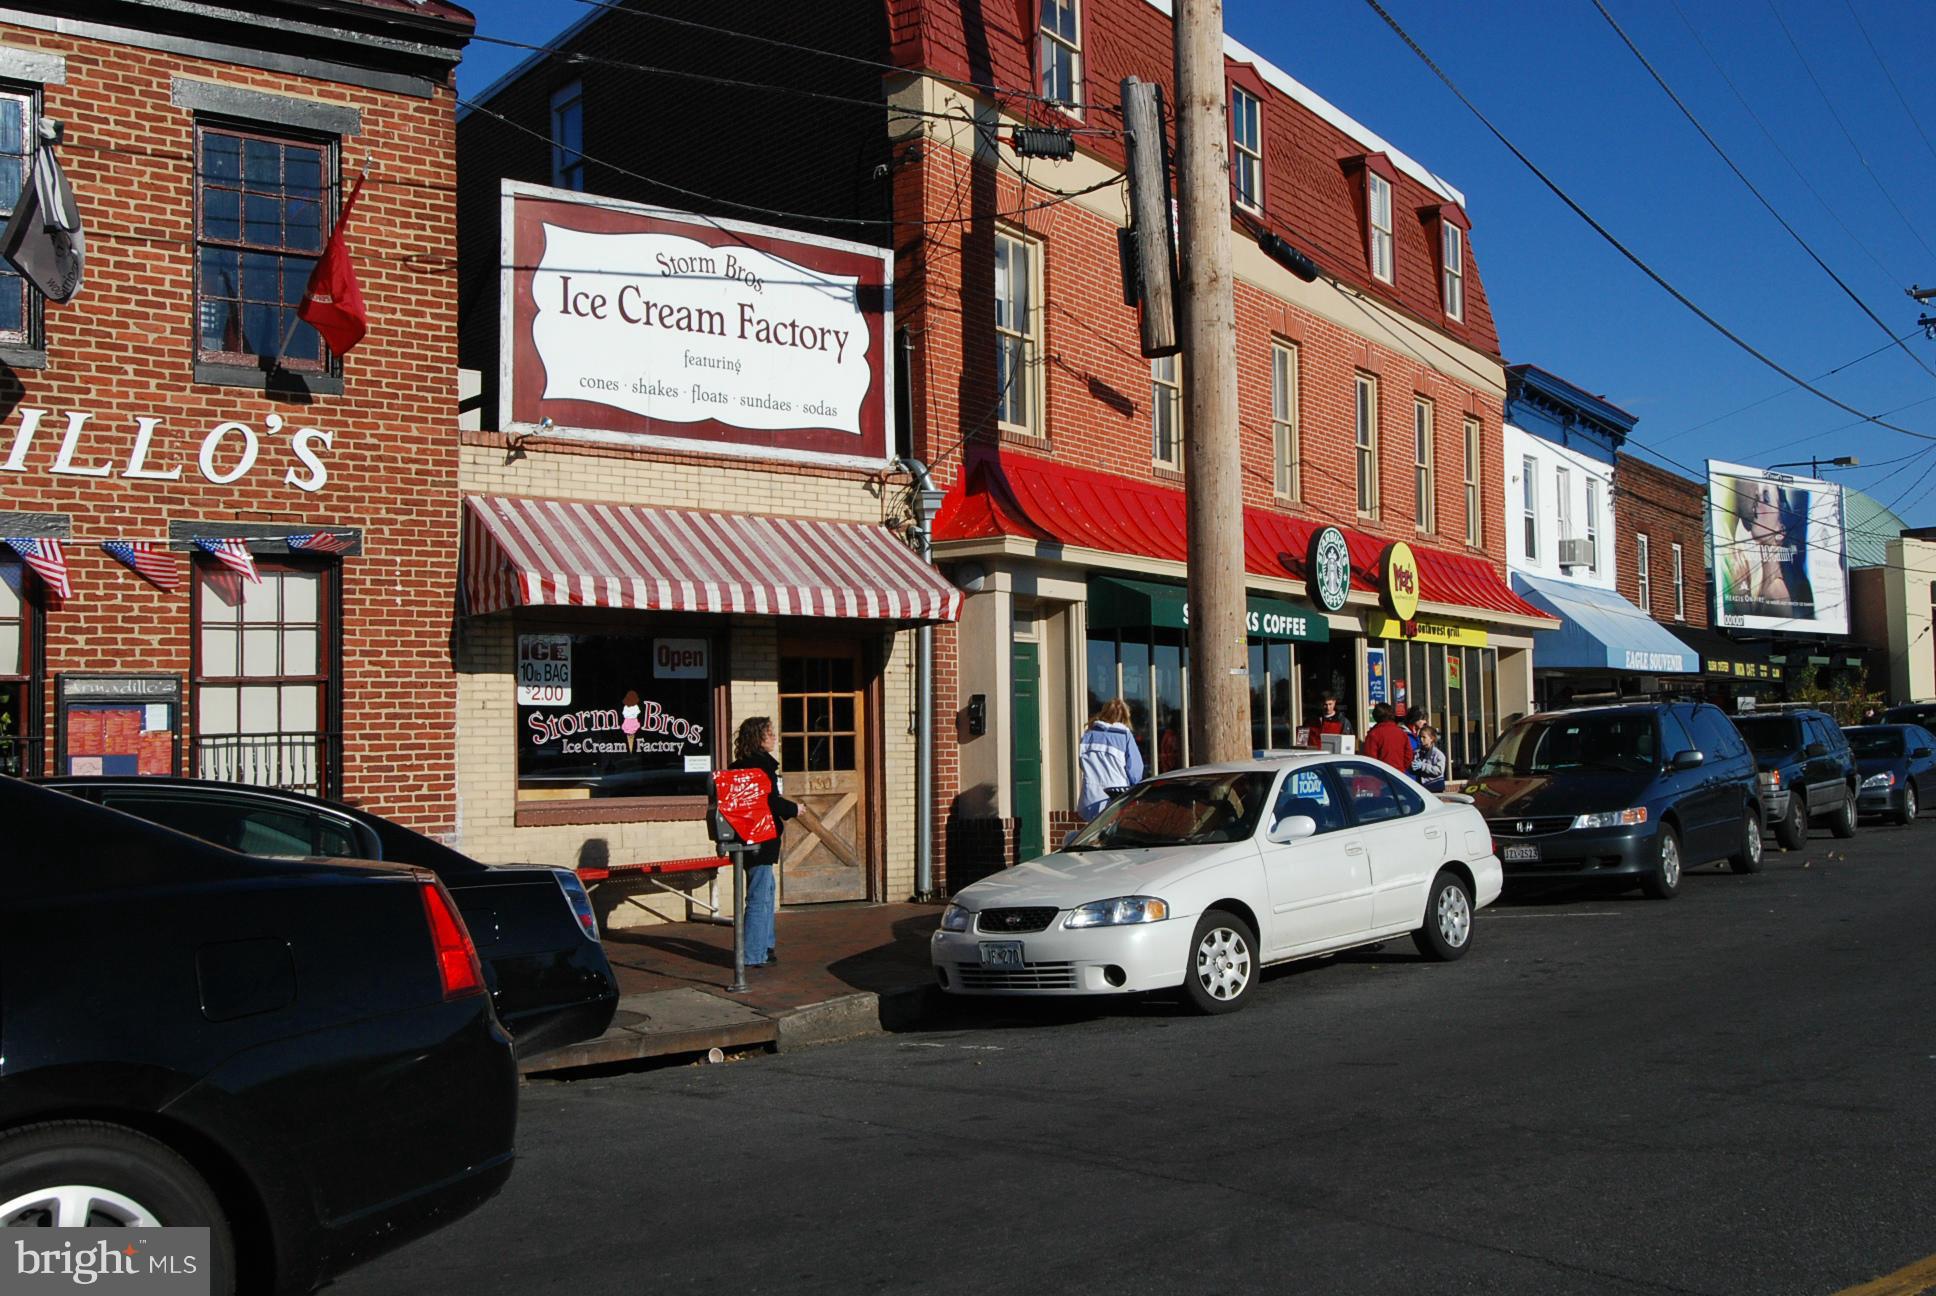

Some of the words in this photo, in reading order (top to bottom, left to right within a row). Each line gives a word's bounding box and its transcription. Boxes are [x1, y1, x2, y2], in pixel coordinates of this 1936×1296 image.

[656, 252, 717, 279] Storm
[725, 254, 764, 295] Bros.
[559, 275, 607, 320] Ice
[618, 284, 726, 337] Cream
[737, 302, 849, 364] Factory
[684, 349, 742, 375] featuring
[579, 376, 619, 392] cones
[632, 379, 679, 398] shakes
[691, 383, 728, 405] floats
[740, 393, 792, 413] sundaes
[803, 401, 838, 417] sodas
[1318, 530, 1348, 566] STARBUCKS
[1393, 563, 1414, 594] Moe's
[1322, 586, 1345, 607] COFFEE
[1263, 613, 1306, 636] COFFEE
[521, 640, 568, 661] ICE
[657, 645, 703, 672] Open
[1625, 650, 1649, 670] EAGLE
[544, 663, 568, 682] BAG
[525, 684, 563, 701] $2.00
[528, 707, 620, 744] Storm
[644, 700, 703, 747] Bros.
[562, 740, 582, 754] Ice
[582, 739, 627, 754] Cream
[636, 738, 684, 756] Factory
[1299, 780, 1322, 794] TODAY
